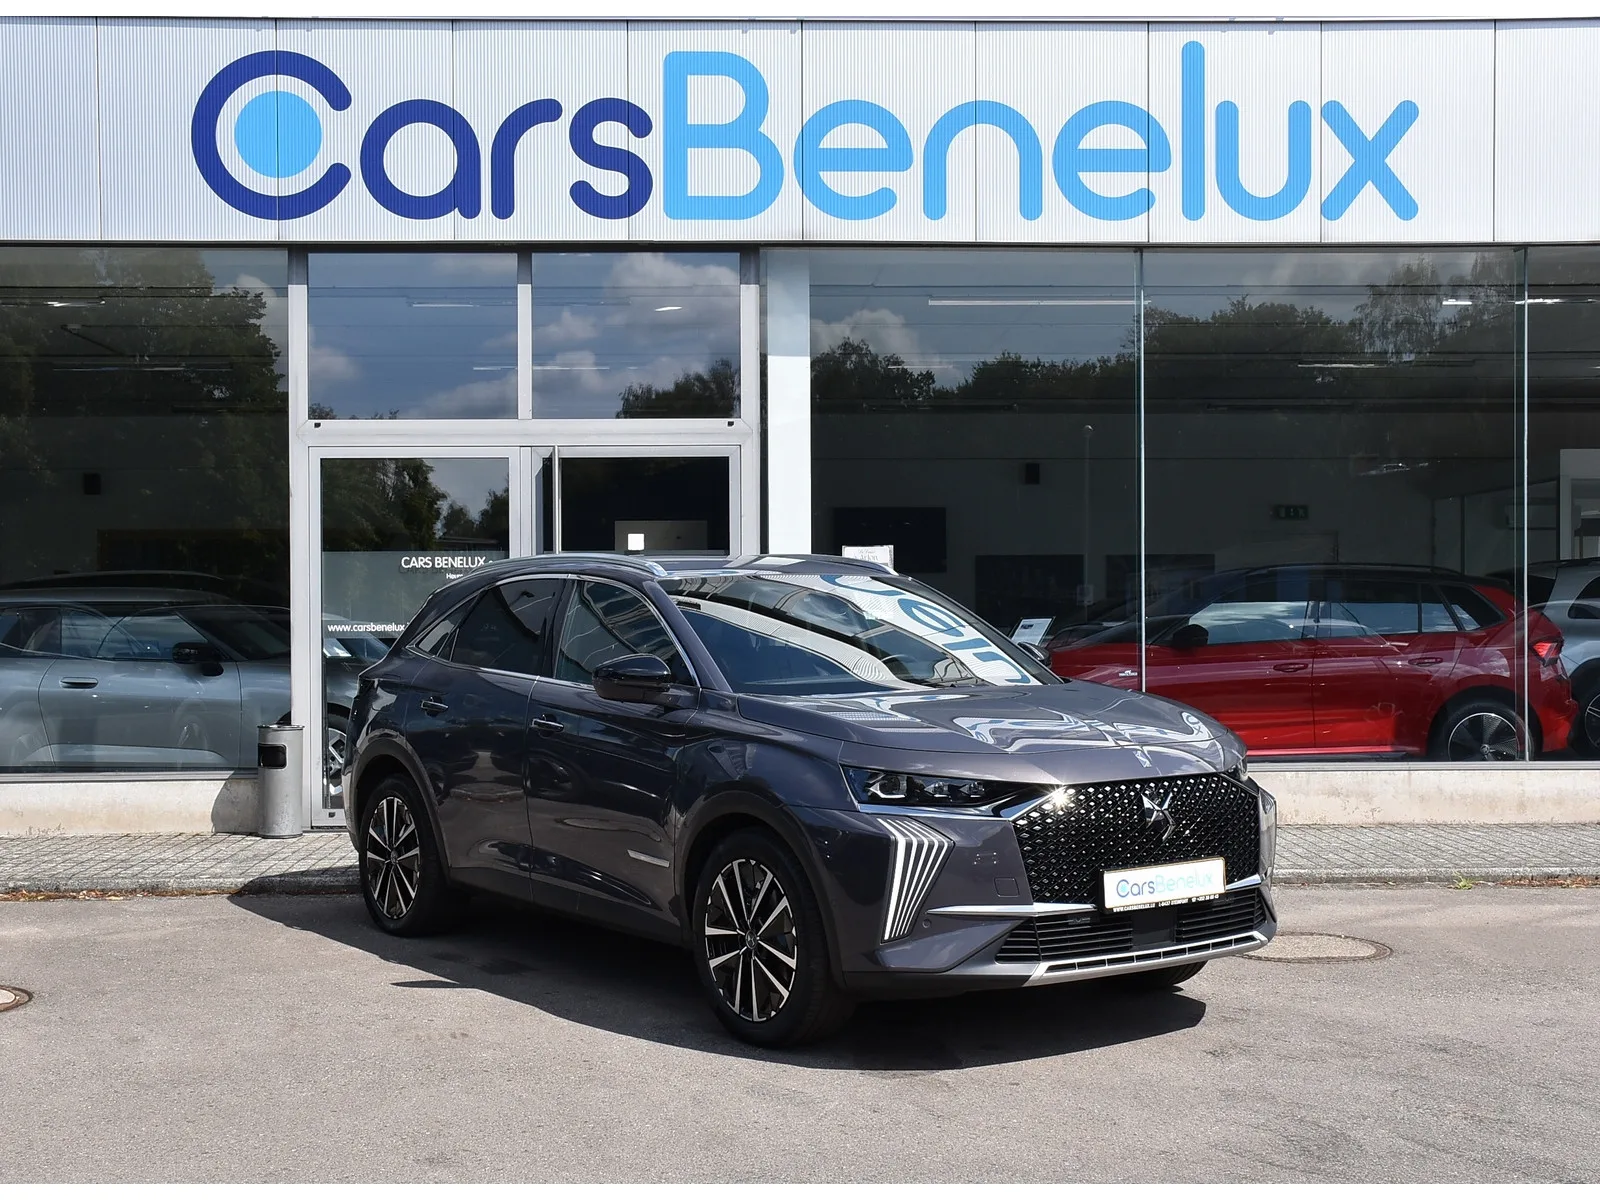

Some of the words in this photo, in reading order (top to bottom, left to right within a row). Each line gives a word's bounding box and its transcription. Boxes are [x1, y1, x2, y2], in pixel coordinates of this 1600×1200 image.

[191, 40, 1419, 221] CarsBenelux
[401, 556, 433, 569] CARS
[434, 556, 486, 569] BENELUX
[327, 622, 410, 632] www.carsbenelux
[1115, 867, 1214, 898] CarsBenelux
